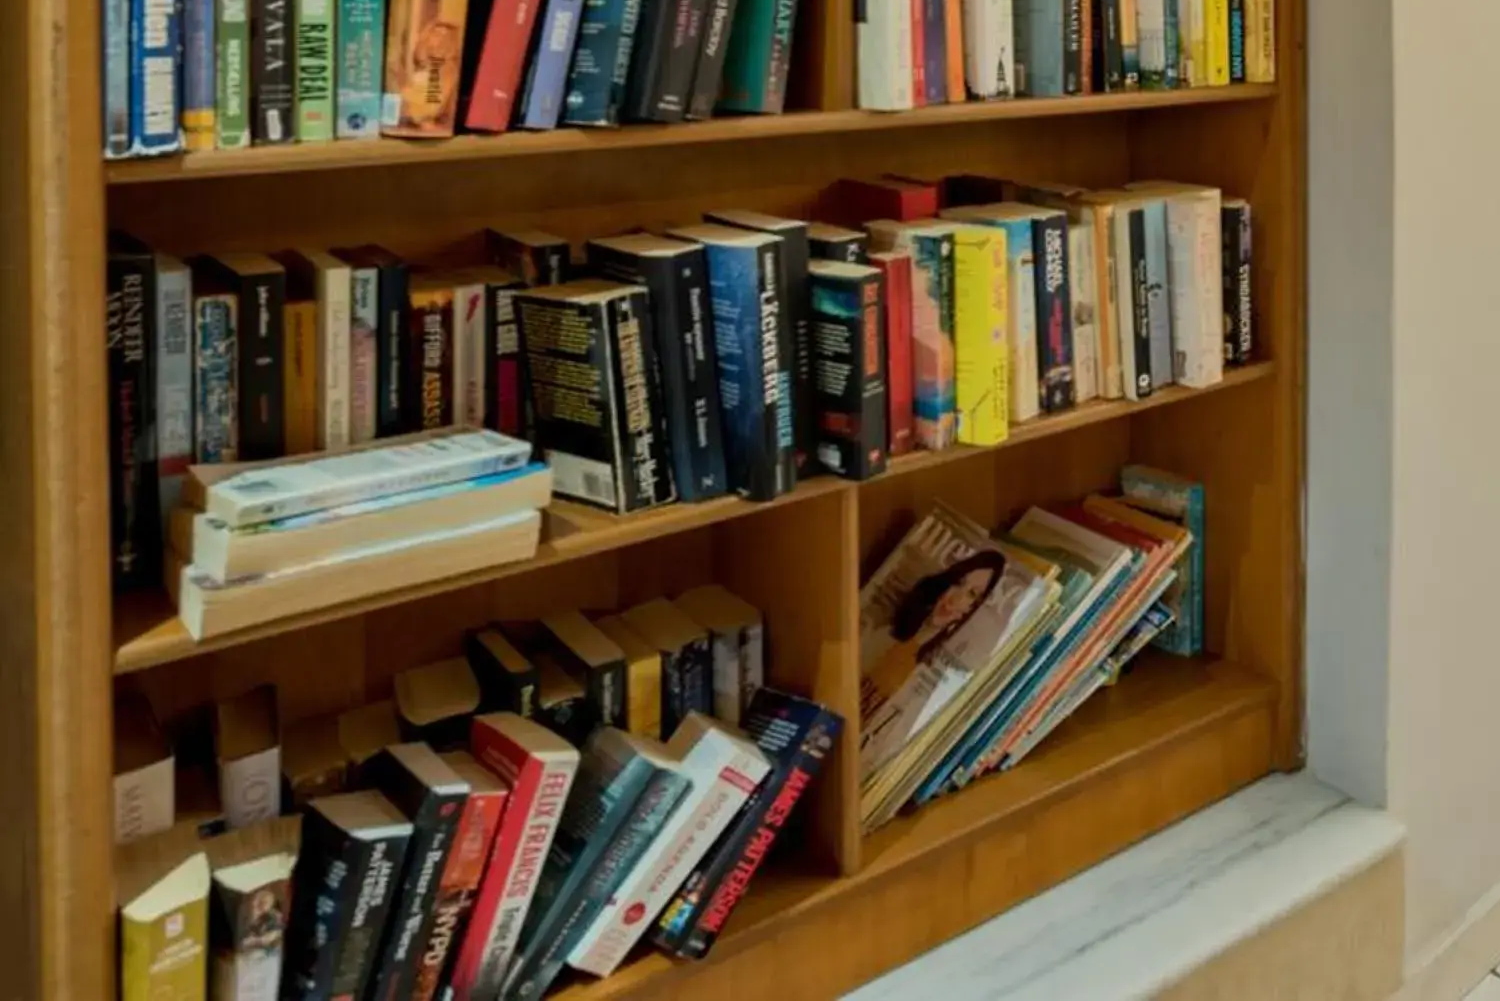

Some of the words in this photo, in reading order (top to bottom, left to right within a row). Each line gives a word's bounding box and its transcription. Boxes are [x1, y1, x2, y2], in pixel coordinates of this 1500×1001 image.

[264, 1, 286, 72] VALA
[299, 21, 329, 60] RAW
[612, 34, 635, 87] GUEST
[298, 64, 329, 103] DEAL
[760, 291, 780, 405] LÄCKBERG
[536, 770, 570, 820] FELIX
[764, 767, 812, 827] JAMES
[350, 841, 388, 929] PATTERSON
[506, 822, 555, 899] FRANCIS
[699, 825, 778, 934] PATTERSON
[423, 905, 462, 967] NYPD
